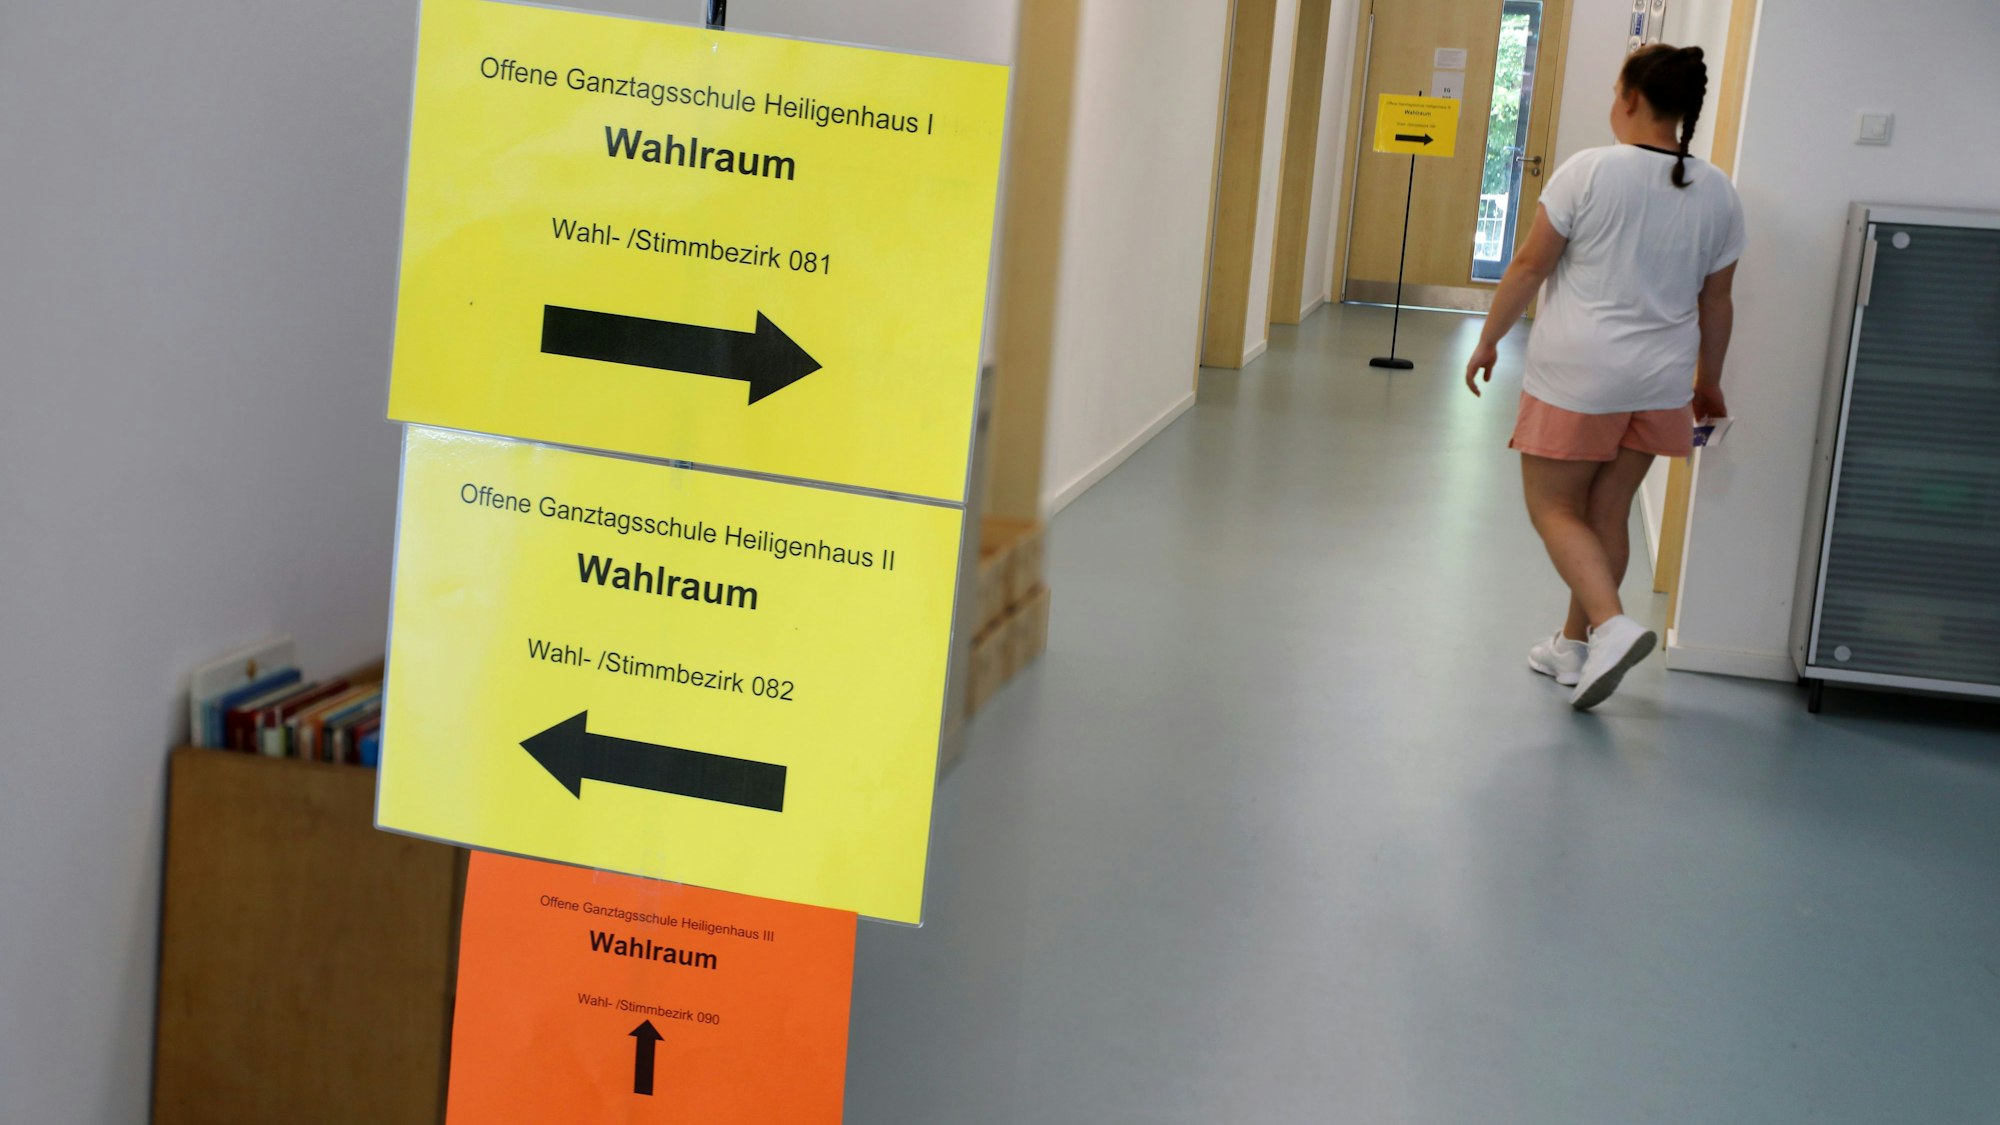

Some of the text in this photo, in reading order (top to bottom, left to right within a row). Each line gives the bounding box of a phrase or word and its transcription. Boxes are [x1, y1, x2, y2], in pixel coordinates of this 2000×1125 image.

[480, 56, 934, 136] Offene Ganztagsschule Heiligenhaus I
[604, 125, 796, 182] Wahlraum
[551, 217, 831, 275] Wahl- /Stimmbezirk 081
[460, 482, 895, 572] Offene Ganztagsschule Heiligenhaus II
[576, 552, 758, 611] Wahlraum
[527, 637, 795, 702] Wahl- /Stimmbezirk 082
[539, 894, 775, 942] Offene Ganztagsschule Heiligenhaus III
[589, 929, 718, 971] Wahlraum
[577, 992, 720, 1026] Wahl- /Stimmbezirk 090
